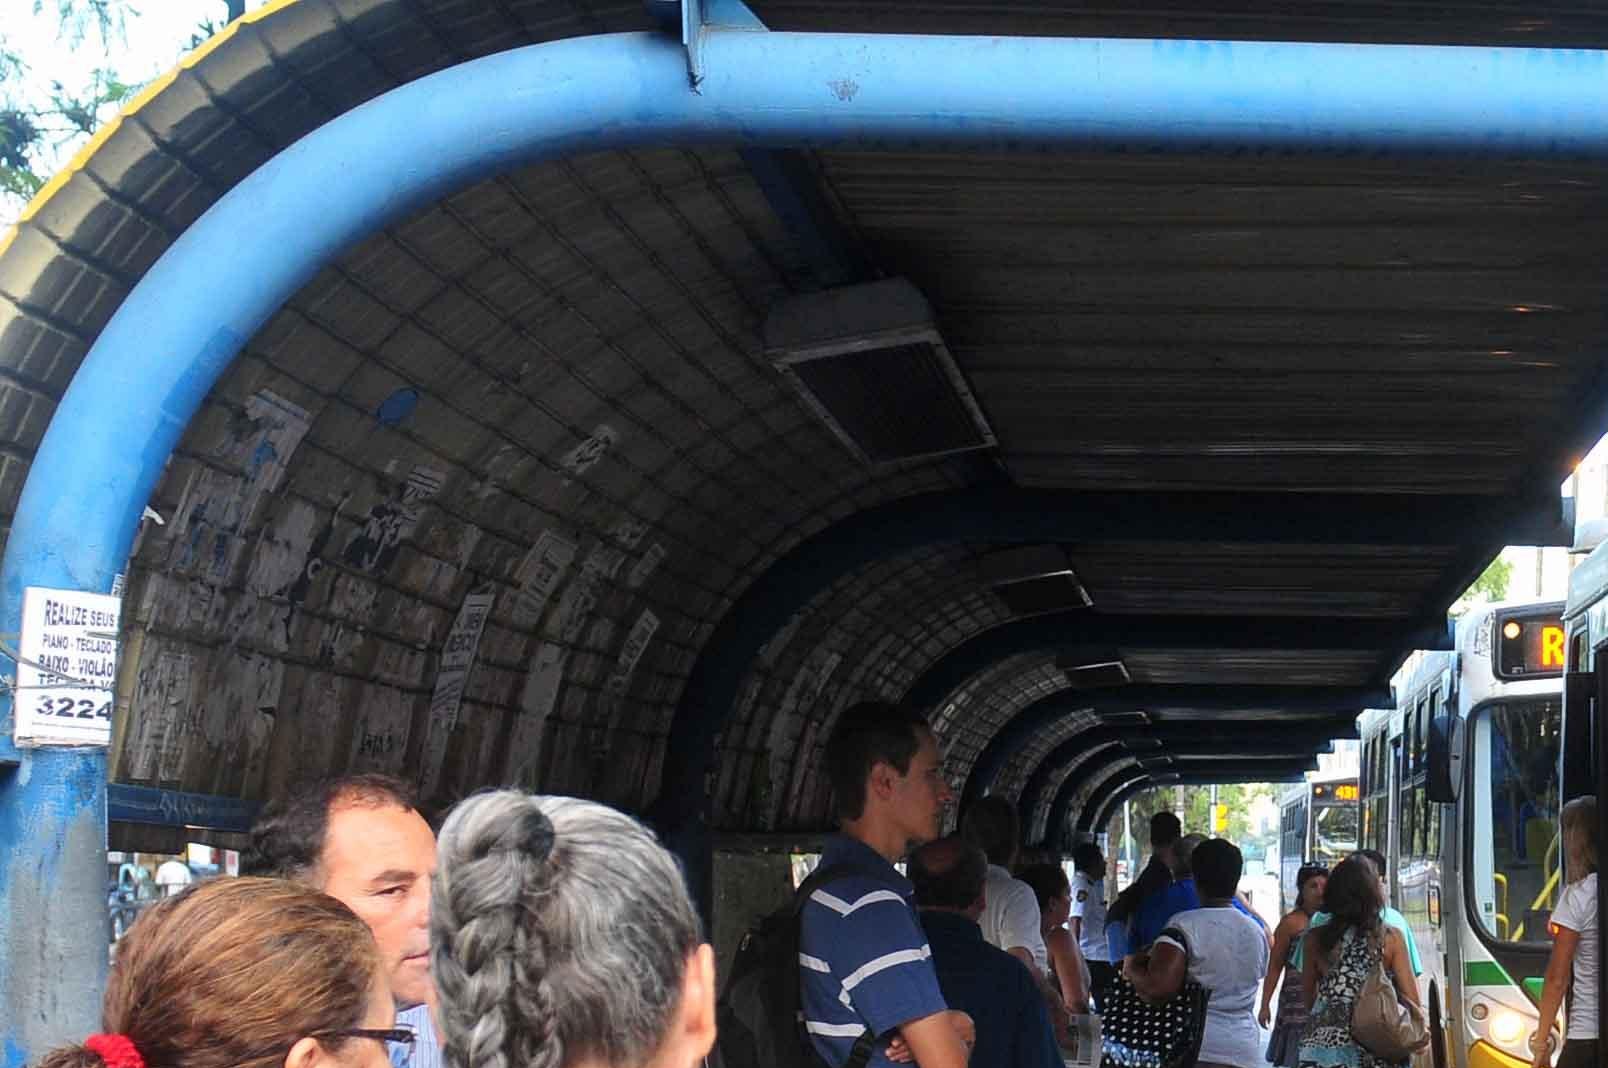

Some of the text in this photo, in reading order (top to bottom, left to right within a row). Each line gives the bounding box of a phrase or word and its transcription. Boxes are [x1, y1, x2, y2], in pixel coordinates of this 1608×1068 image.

[44, 599, 115, 627] REALIZE SEUS
[42, 633, 69, 650] PIANO
[76, 637, 113, 655] TECLADO
[39, 654, 70, 673] BAIXO
[78, 656, 114, 678] VIOLÃO
[36, 695, 113, 722] 3224
